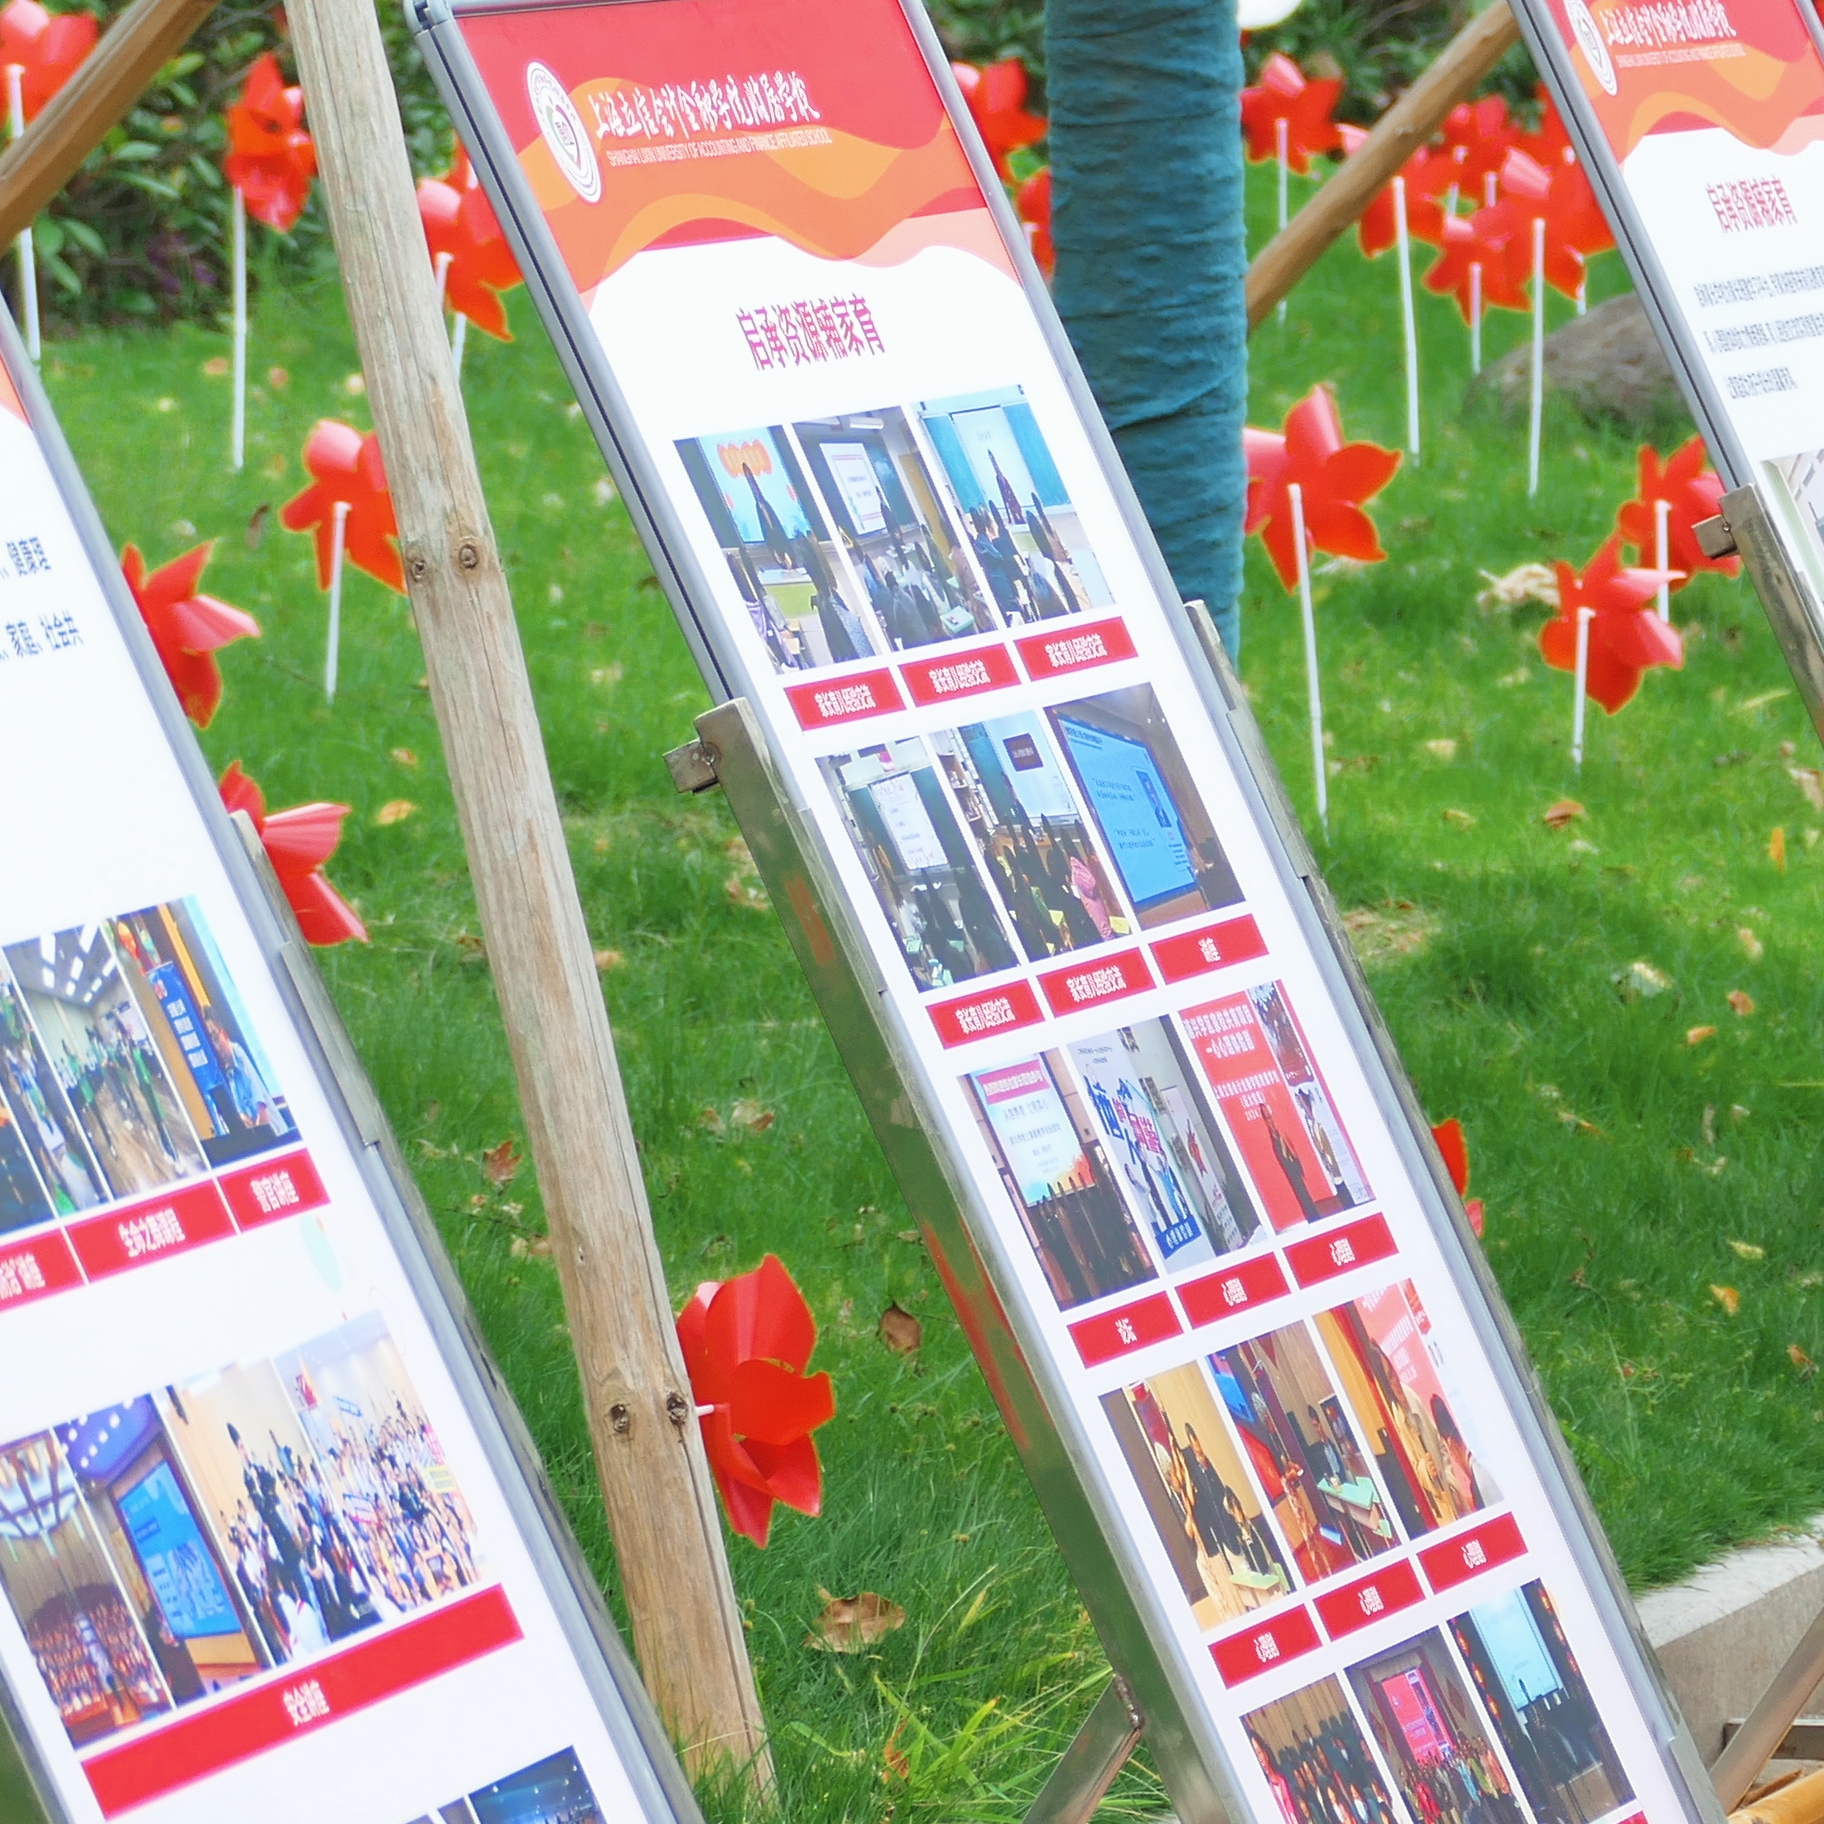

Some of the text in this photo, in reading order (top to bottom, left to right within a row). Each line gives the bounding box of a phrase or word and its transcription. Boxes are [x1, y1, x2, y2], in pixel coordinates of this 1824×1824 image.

[587, 69, 821, 140] 上海立信会计金融学院附属学校
[736, 292, 885, 371] 启承资源辅家育
